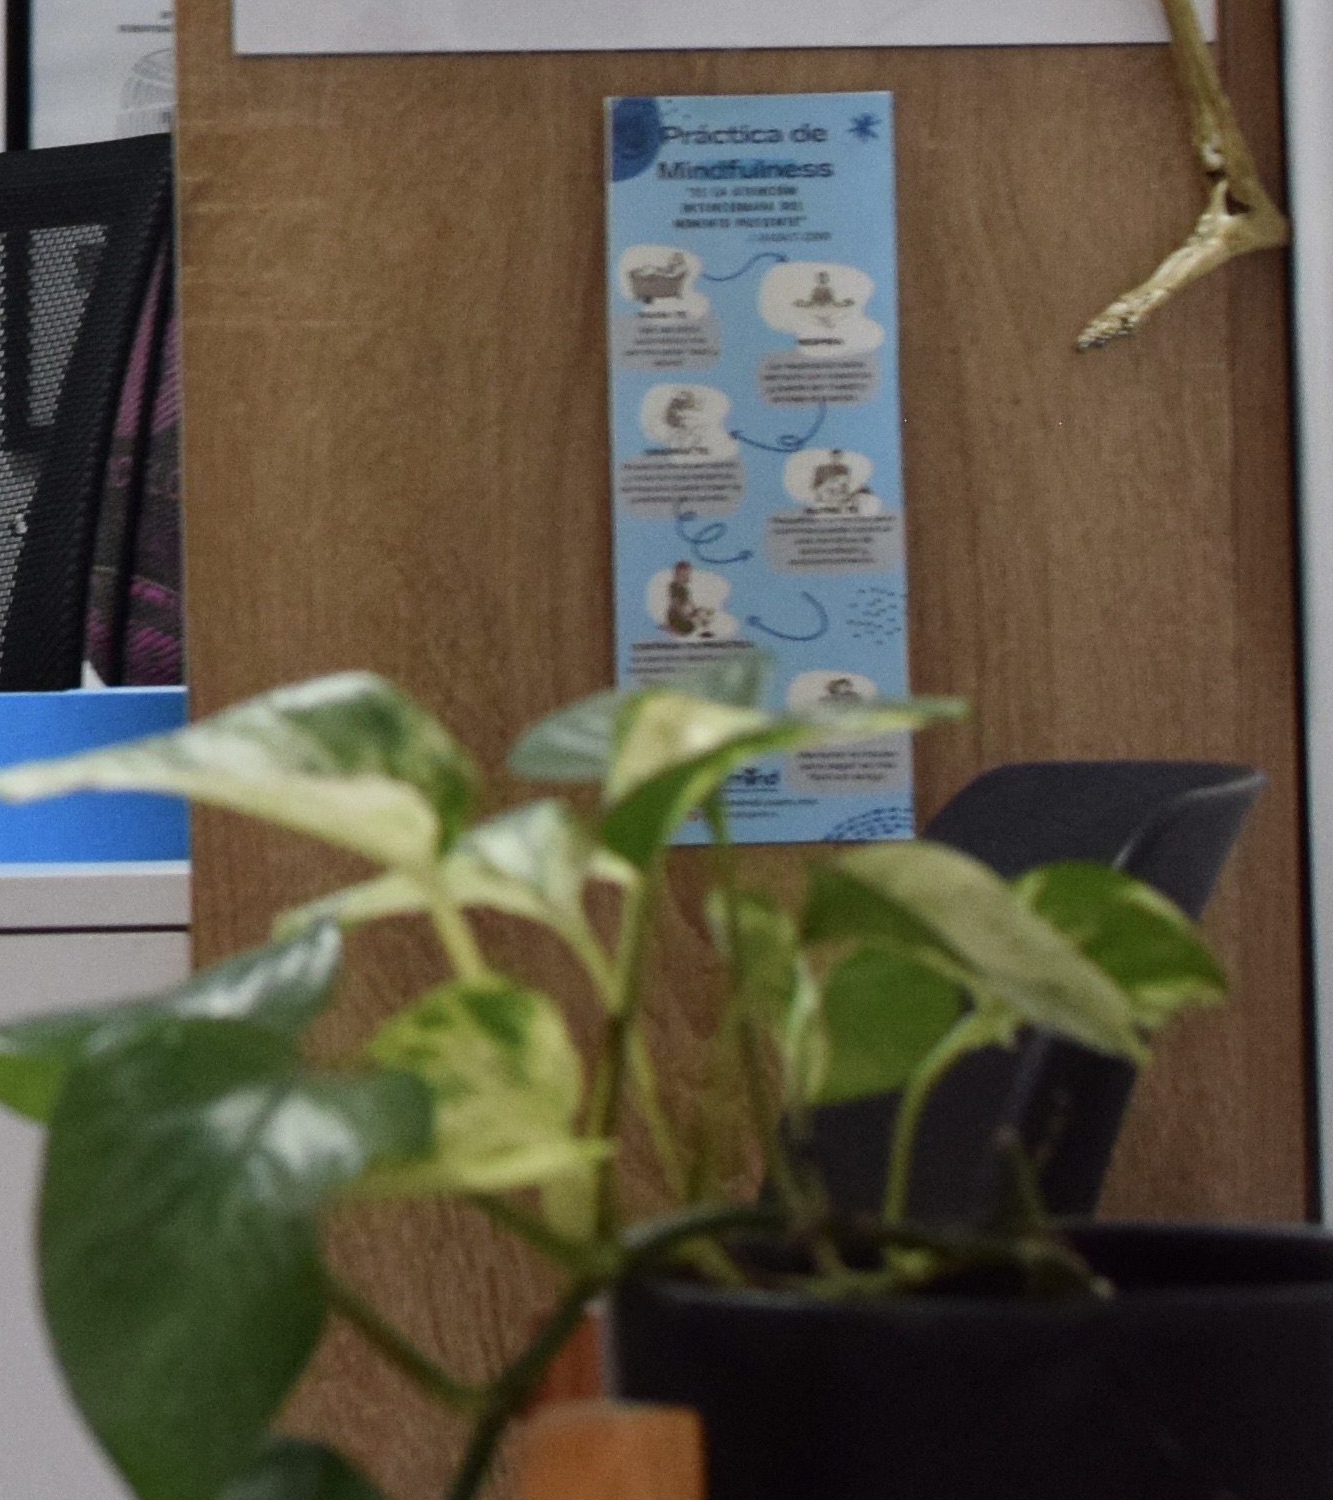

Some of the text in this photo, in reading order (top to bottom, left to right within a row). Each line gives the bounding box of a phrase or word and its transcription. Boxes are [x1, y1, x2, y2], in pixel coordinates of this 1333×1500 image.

[660, 122, 829, 145] Práctica de
[656, 158, 835, 181] Mindfulness
